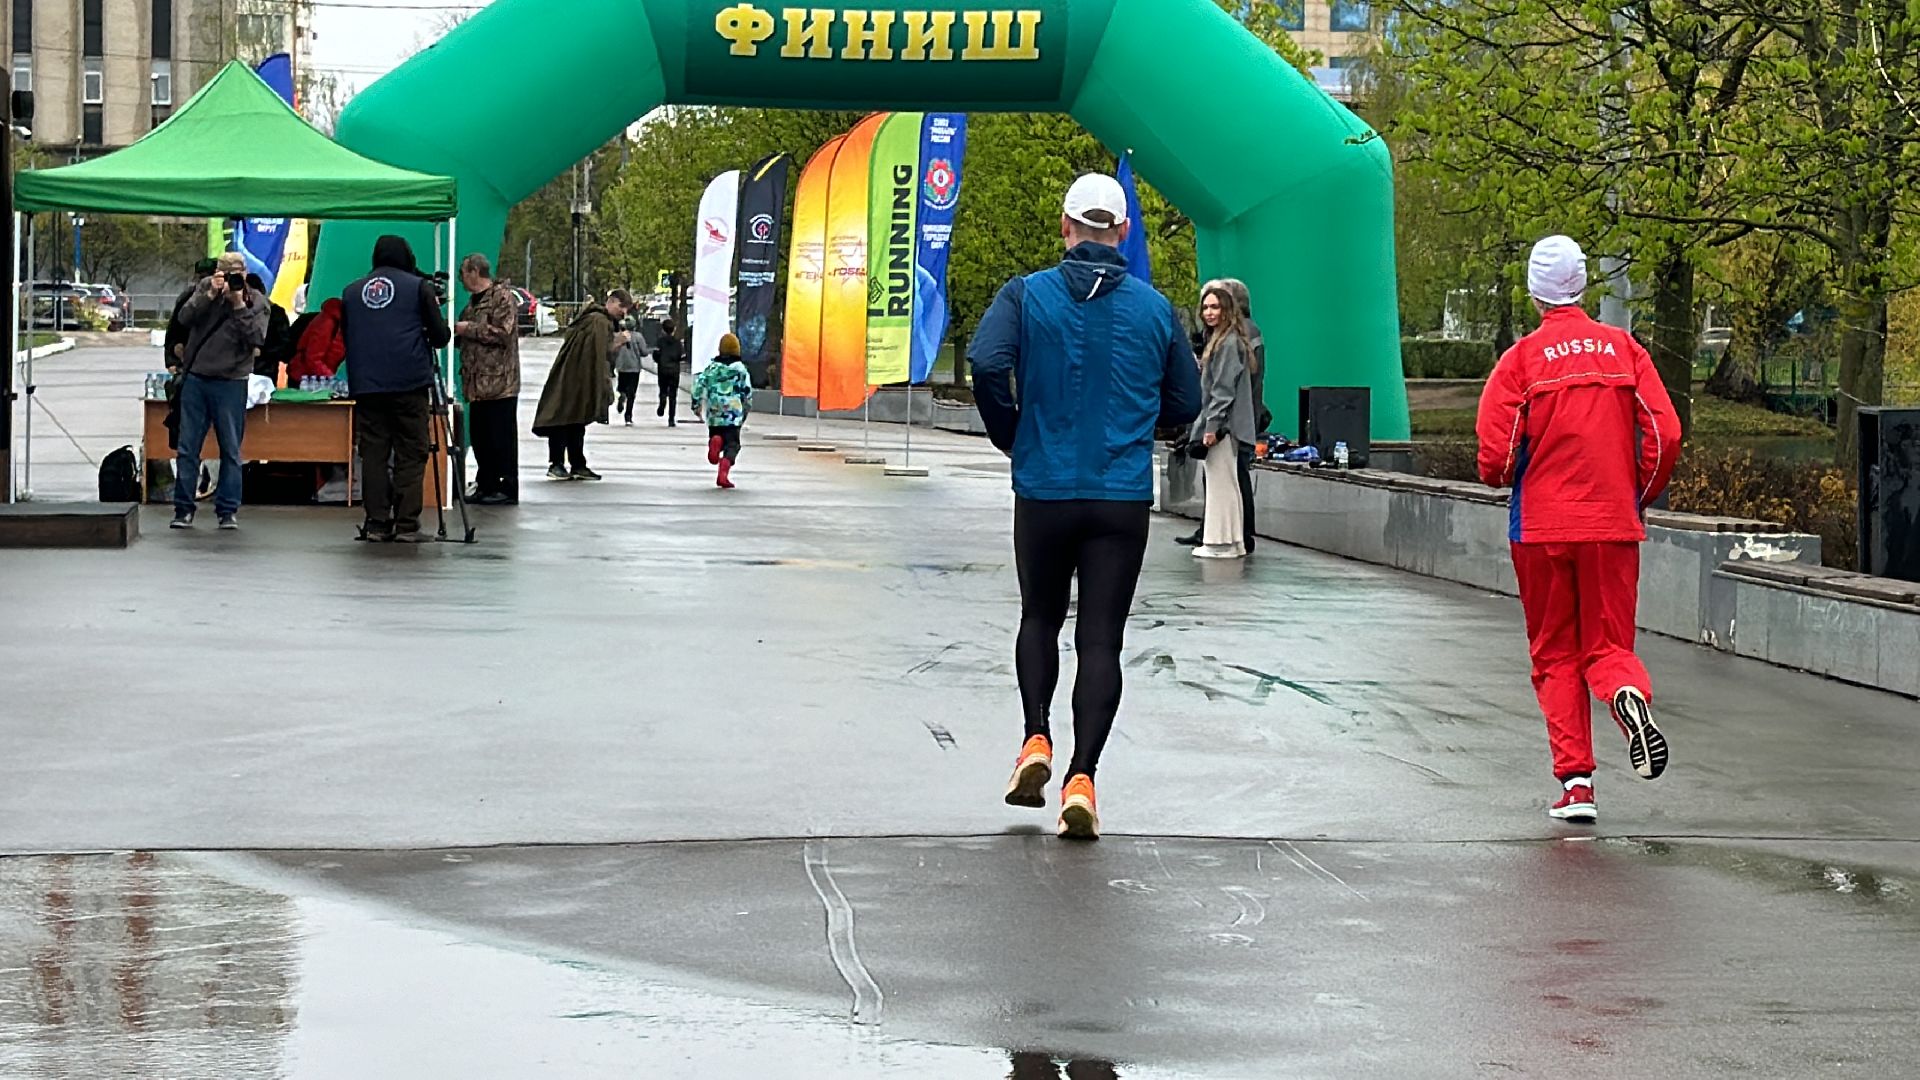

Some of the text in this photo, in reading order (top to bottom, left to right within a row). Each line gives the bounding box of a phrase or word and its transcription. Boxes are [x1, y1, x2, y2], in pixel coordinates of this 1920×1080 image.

[715, 3, 1041, 60] ФИНИШ
[888, 164, 913, 317] RUNNING
[1543, 338, 1616, 362] RUSSIA
